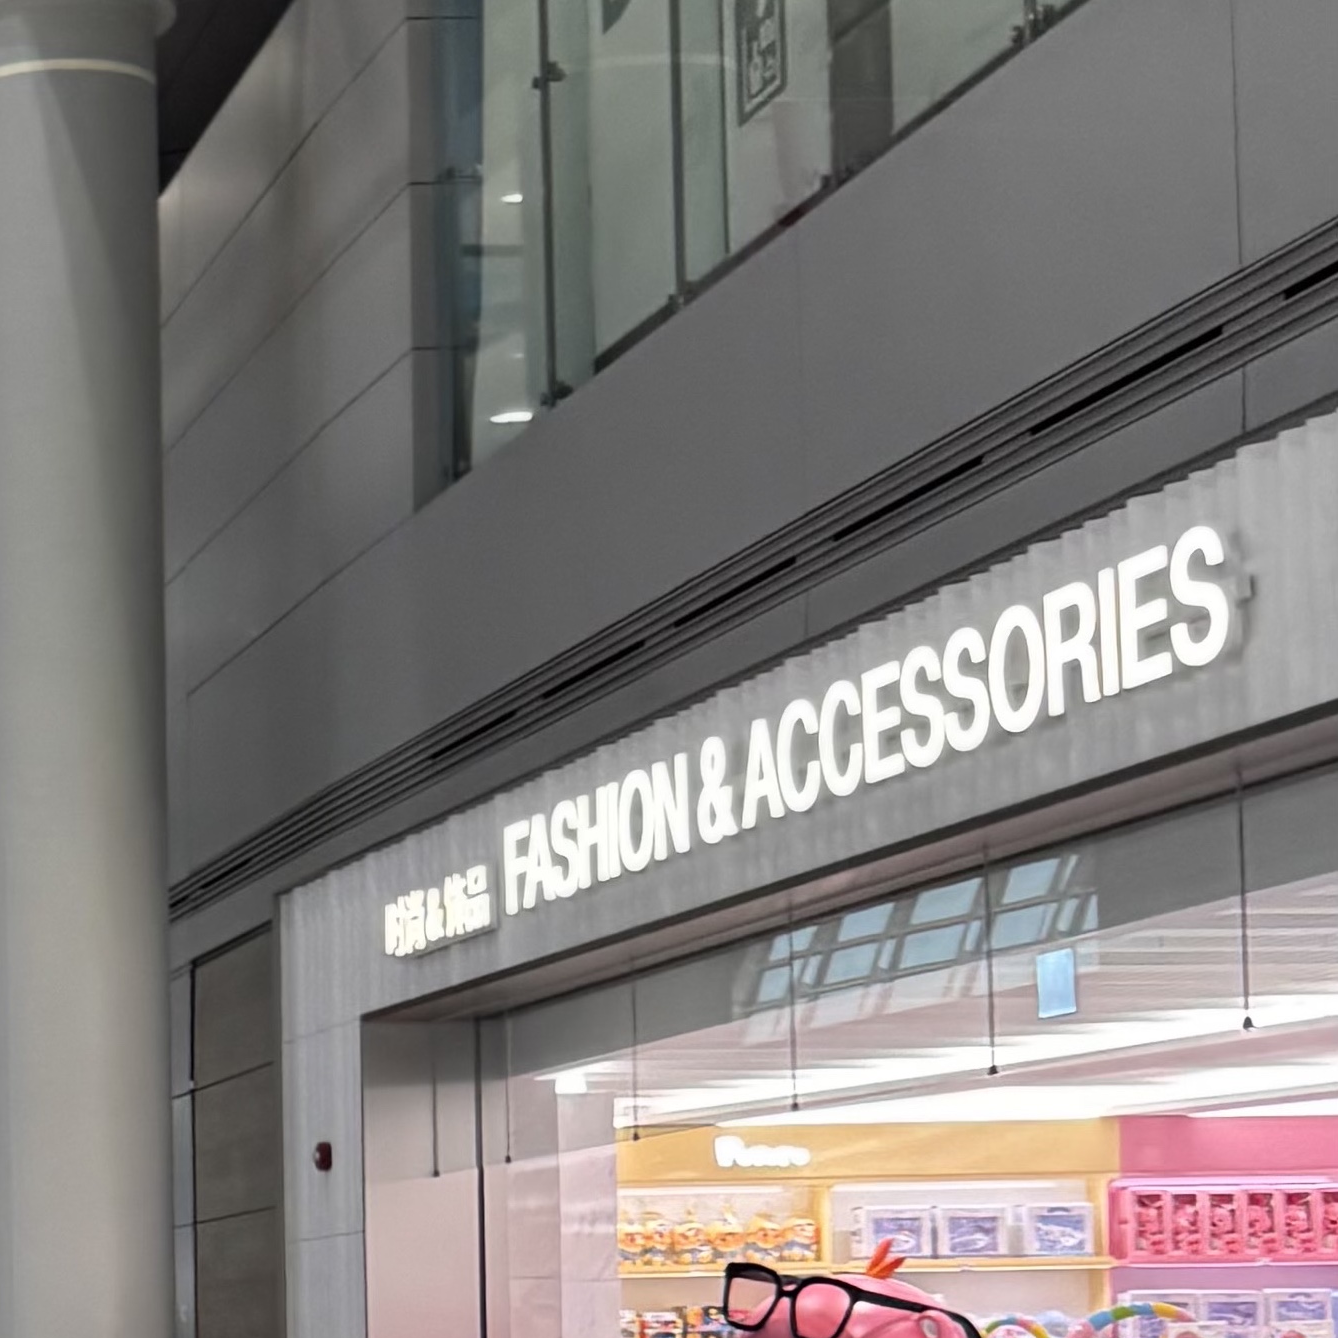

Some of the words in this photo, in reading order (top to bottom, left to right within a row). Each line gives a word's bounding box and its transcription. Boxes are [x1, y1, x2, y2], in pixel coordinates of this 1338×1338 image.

[503, 752, 691, 916] FASHION
[696, 735, 739, 844] &
[741, 525, 1230, 830] ACCESSORIES
